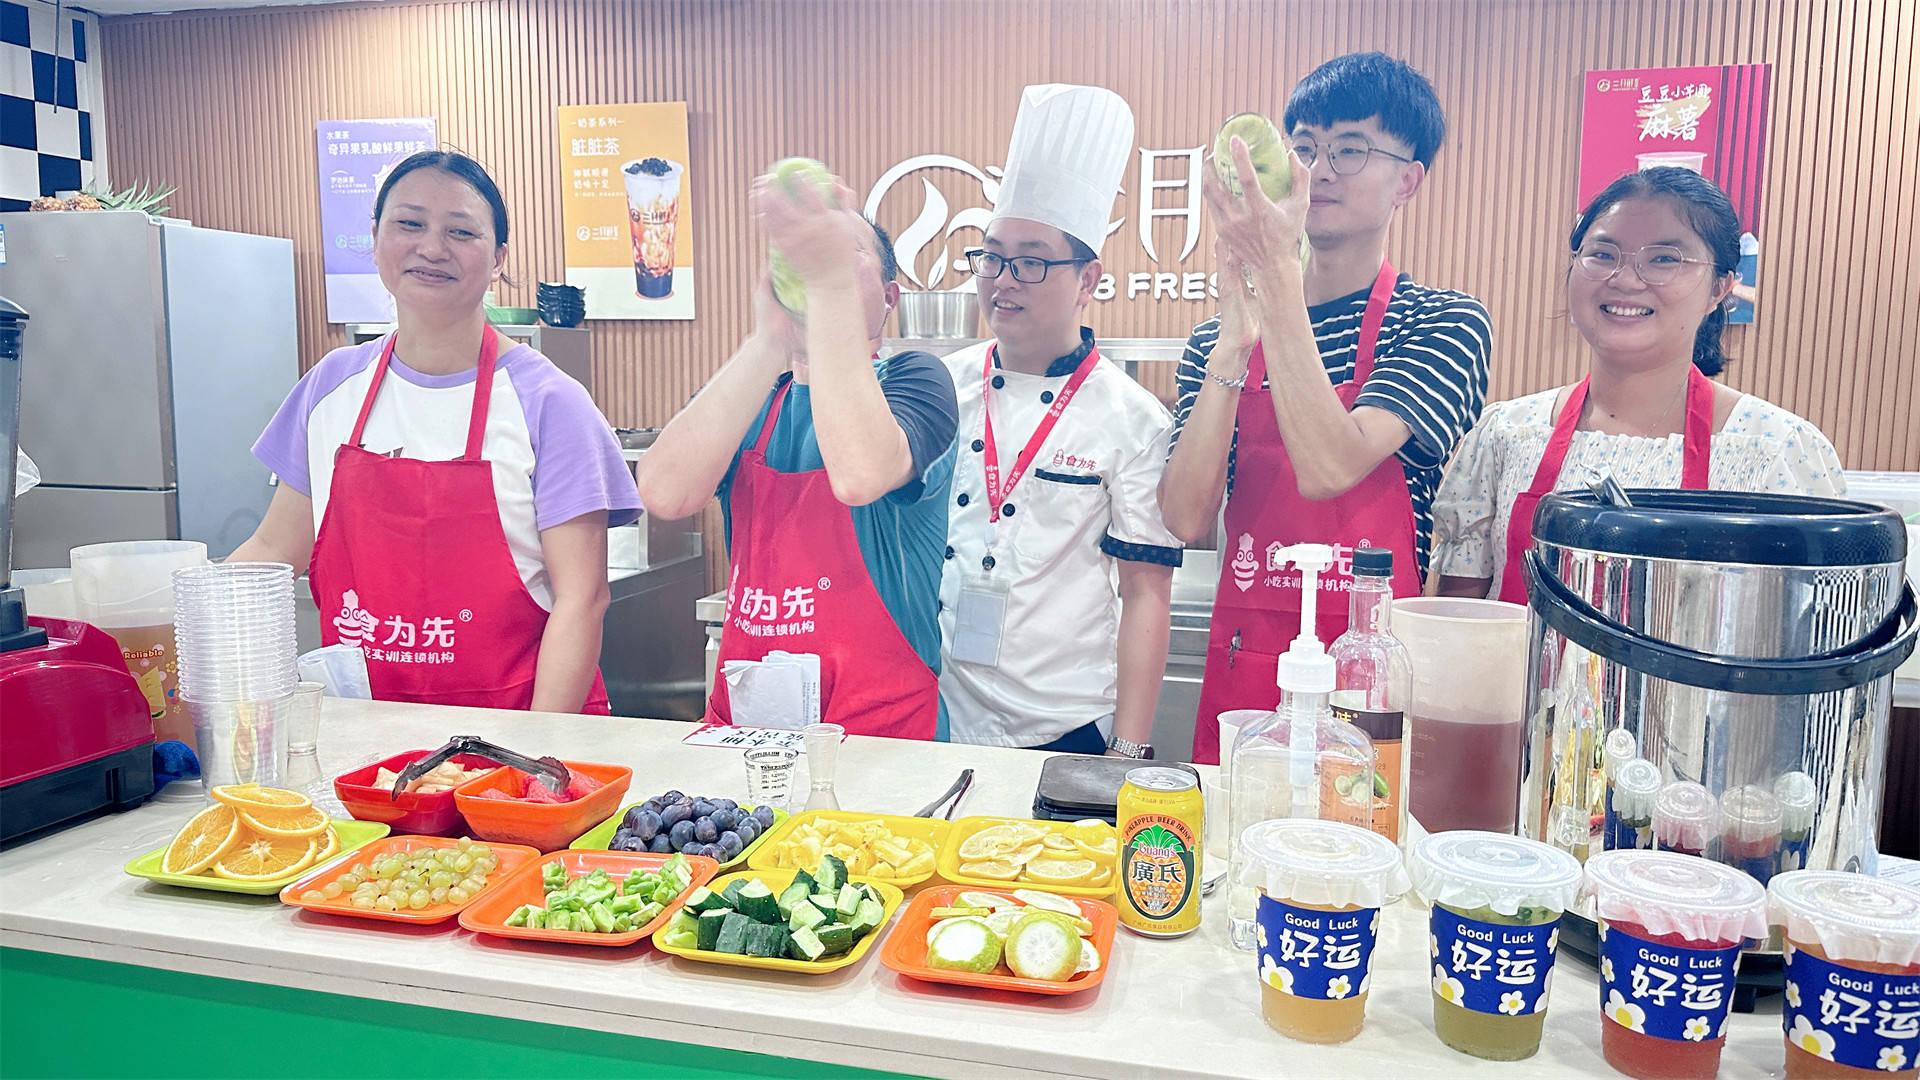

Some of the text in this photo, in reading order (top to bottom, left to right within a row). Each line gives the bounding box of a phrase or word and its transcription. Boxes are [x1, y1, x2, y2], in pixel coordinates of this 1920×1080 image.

[1639, 103, 1700, 142] 麻薯
[571, 137, 620, 156] 脏脏茶
[1065, 454, 1098, 472] 食为先
[124, 649, 164, 659] Reliable
[1125, 816, 1193, 841] PINEAPPLE BEER DRINK
[1131, 860, 1183, 884] 廣氏
[1284, 913, 1359, 930] Good Luck
[1456, 924, 1535, 944] Good Luck
[1279, 927, 1362, 970] 好运
[1638, 948, 1723, 969] Good Luck
[1450, 938, 1538, 985] 好运
[1630, 962, 1725, 1011] 好运
[1828, 972, 1920, 996] Good Luck
[1818, 988, 1920, 1040] 好运
